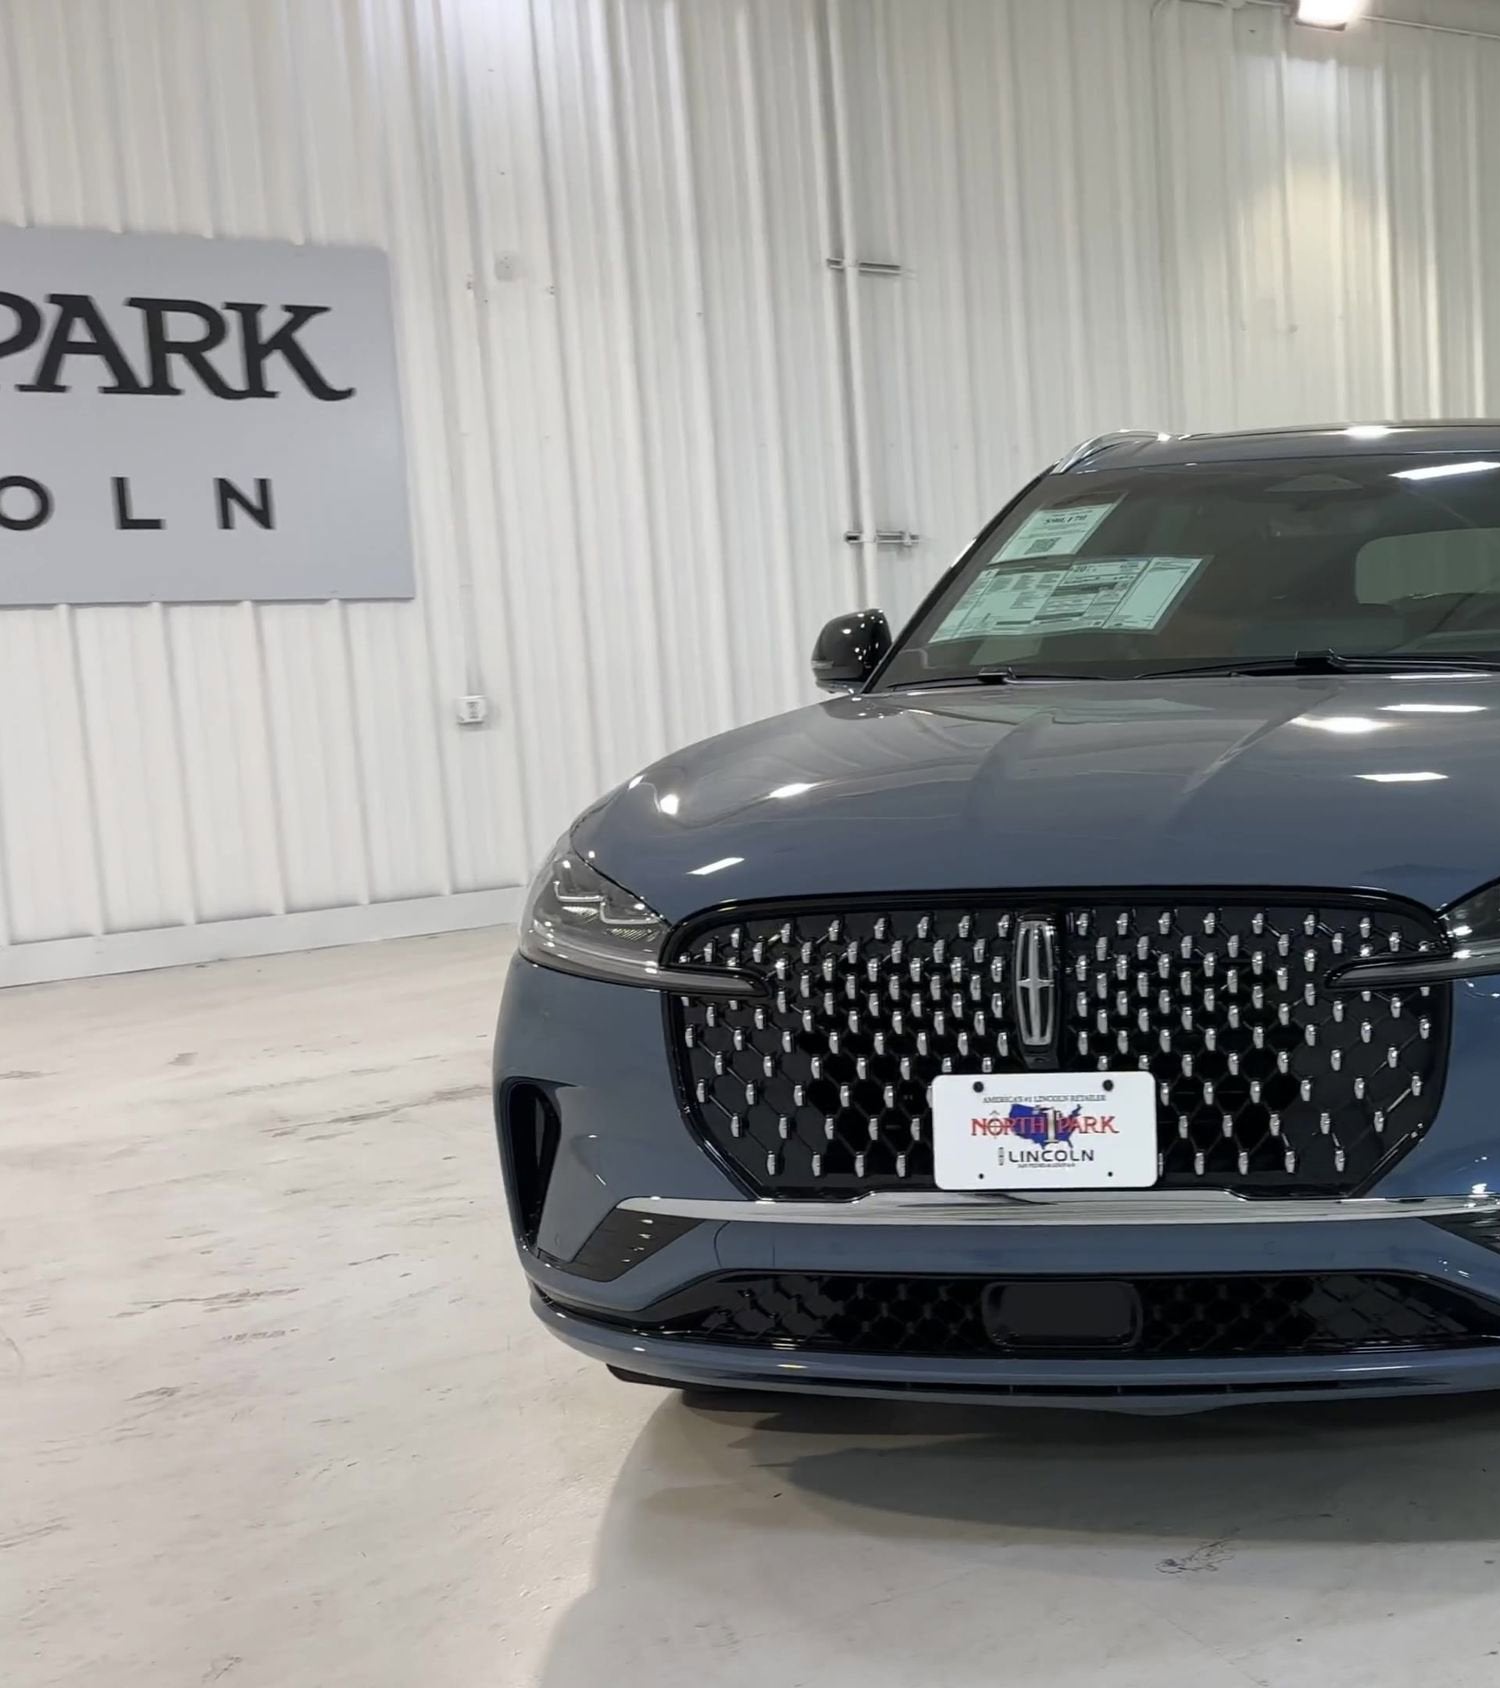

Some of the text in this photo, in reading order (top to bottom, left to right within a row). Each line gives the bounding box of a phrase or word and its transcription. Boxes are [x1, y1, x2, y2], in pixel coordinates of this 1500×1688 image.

[971, 1117, 1045, 1136] NORTH
[1058, 1115, 1119, 1135] PARK
[1009, 1150, 1094, 1163] LINCOLN
